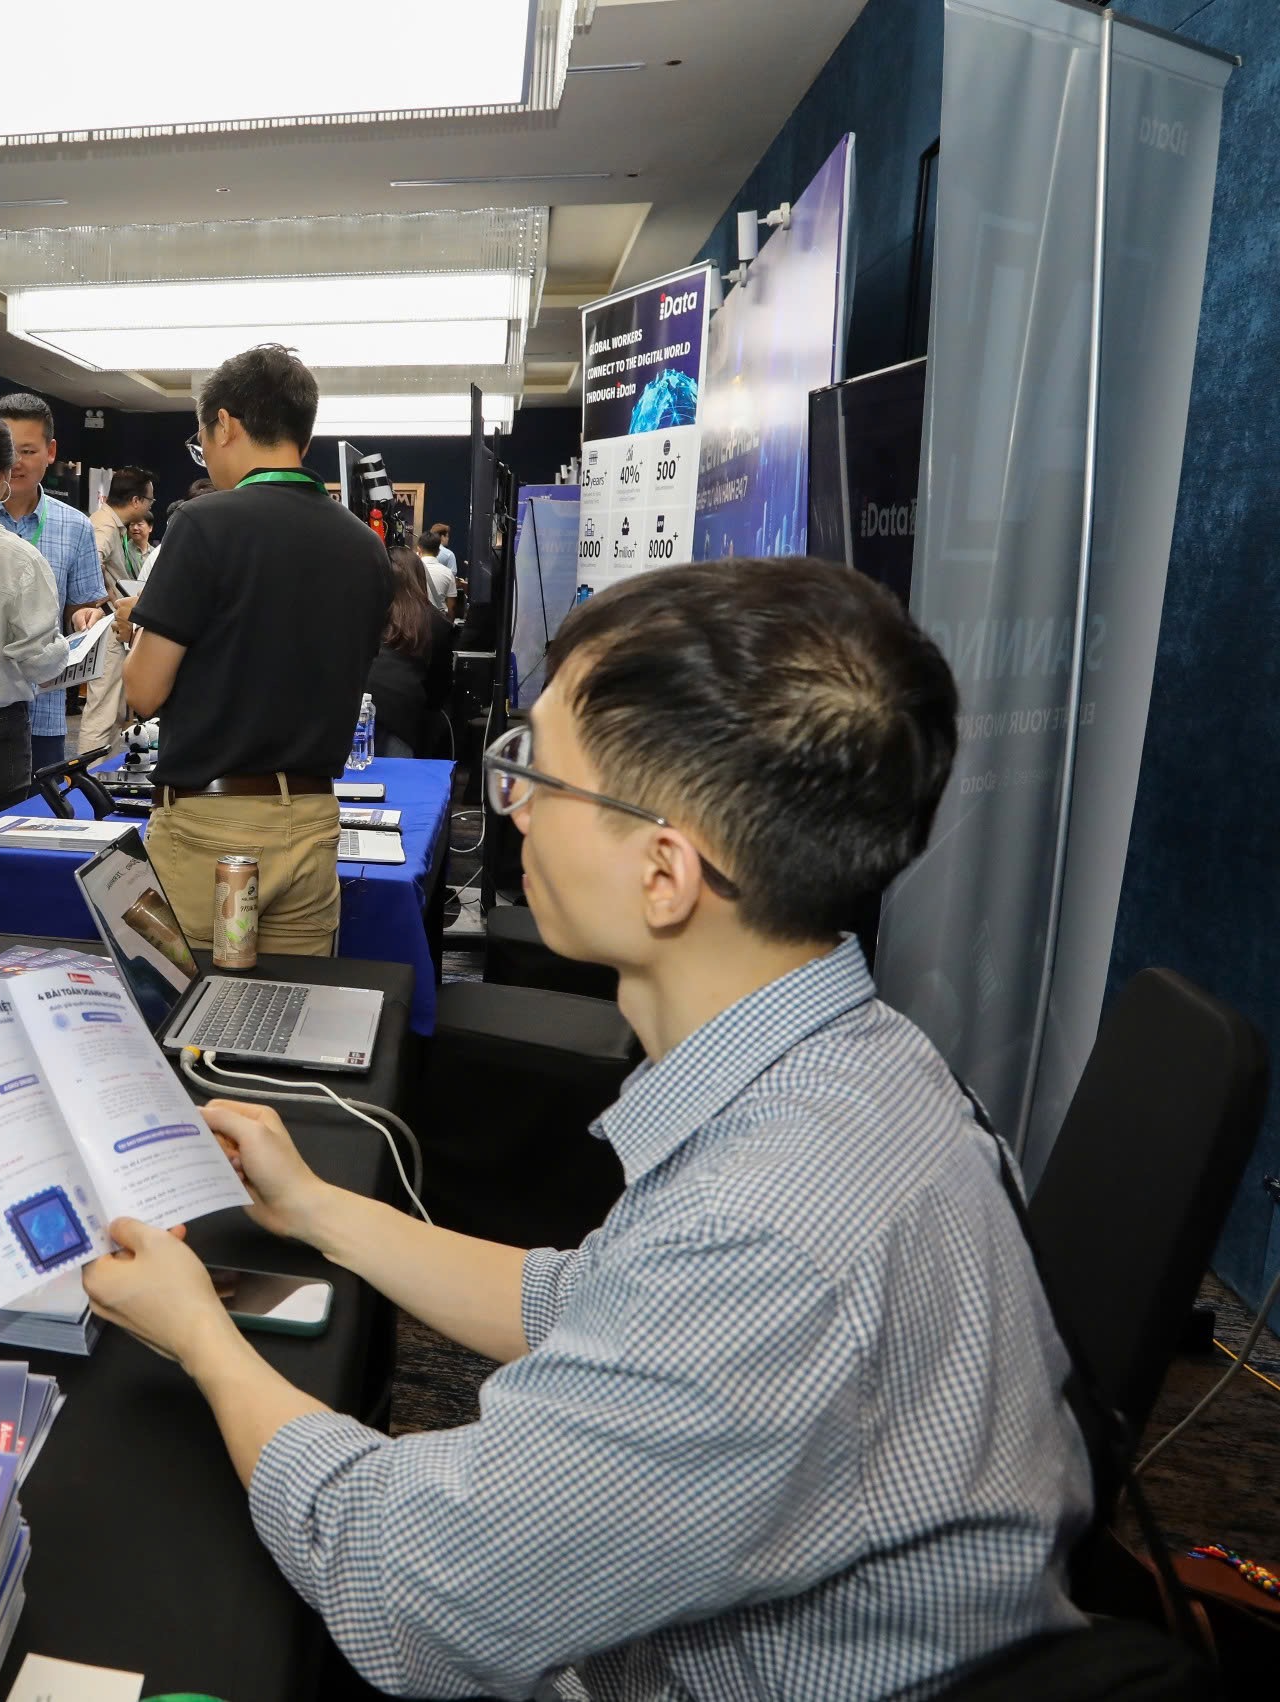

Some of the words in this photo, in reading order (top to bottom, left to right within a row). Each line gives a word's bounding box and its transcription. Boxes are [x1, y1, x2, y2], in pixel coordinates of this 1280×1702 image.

[659, 291, 698, 321] iData
[589, 338, 611, 356] GLOBAL
[612, 329, 643, 350] WORKERS
[587, 362, 615, 380] CONNECT
[615, 360, 625, 373] TO
[626, 356, 637, 370] THE
[637, 348, 664, 368] DIGITAL
[664, 341, 691, 359] WORLD
[586, 387, 615, 404] THROUGH
[45, 988, 61, 1000] BÀI
